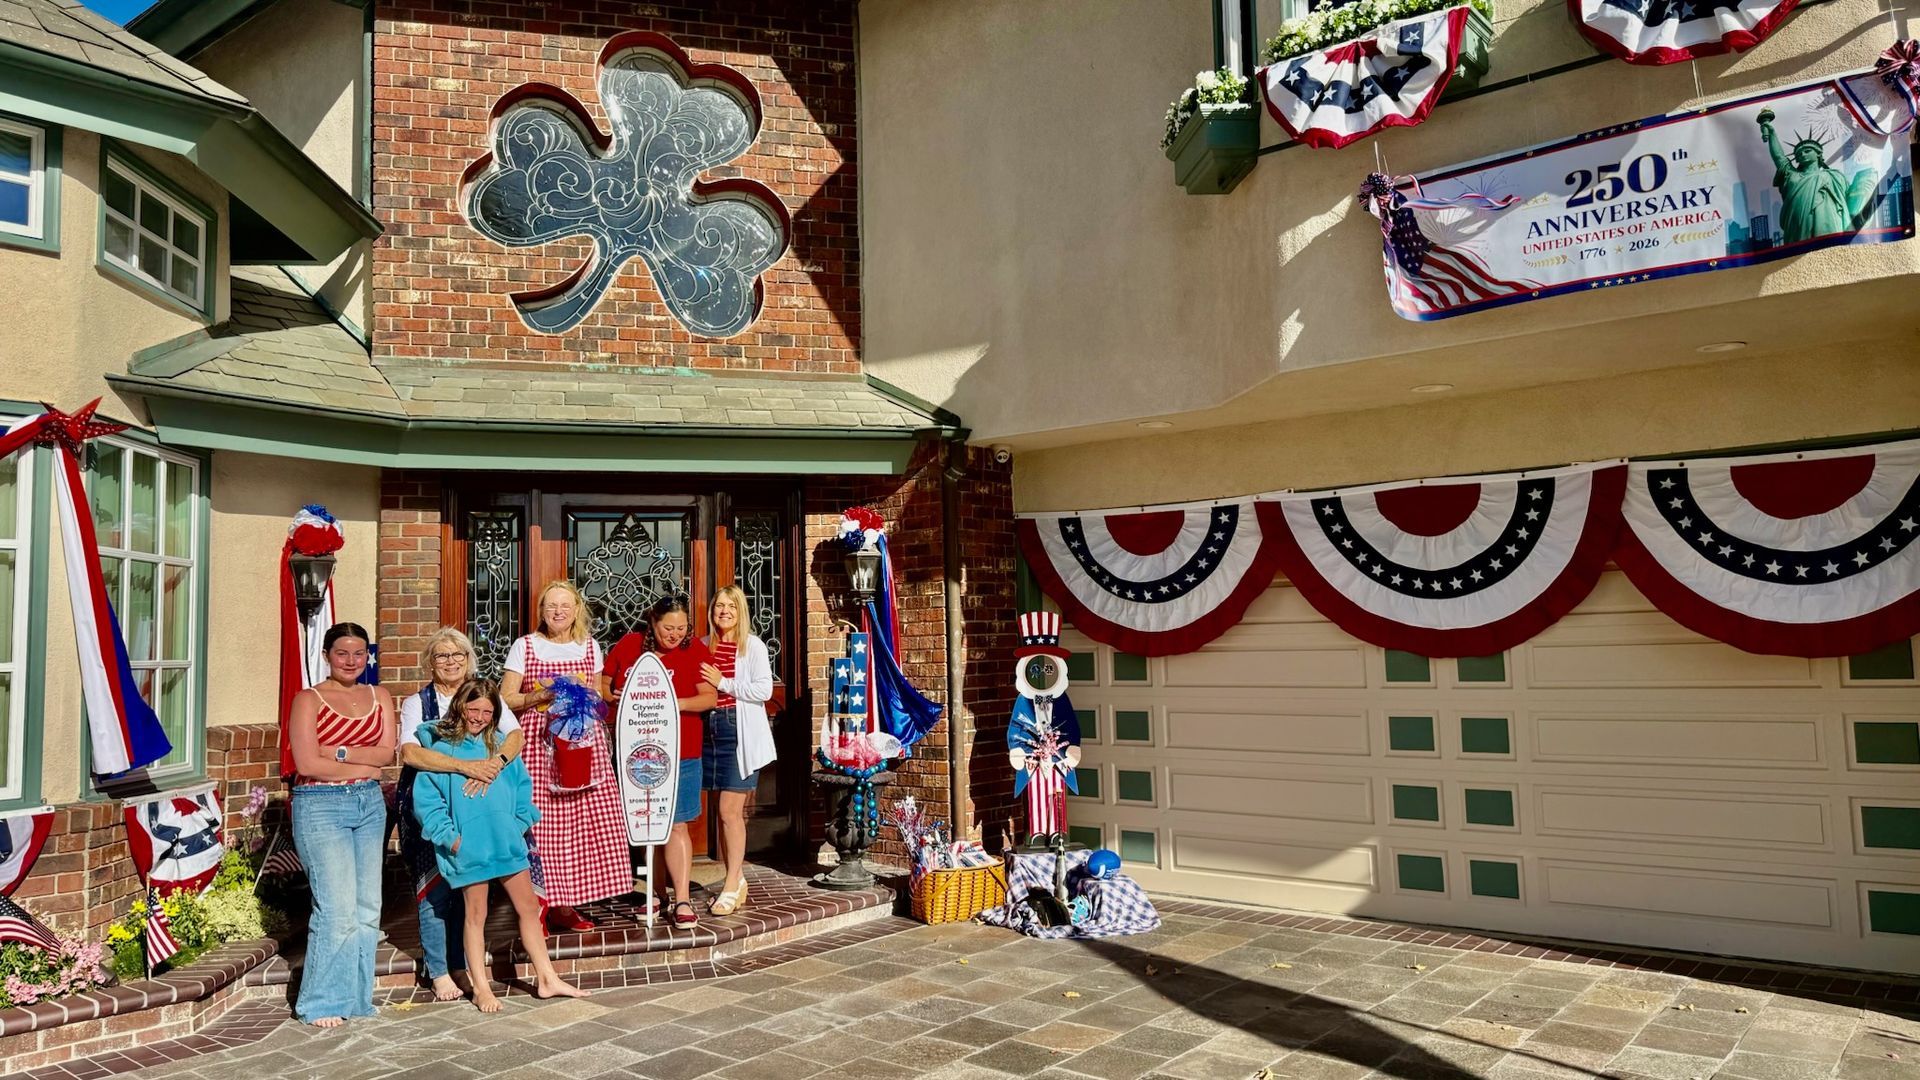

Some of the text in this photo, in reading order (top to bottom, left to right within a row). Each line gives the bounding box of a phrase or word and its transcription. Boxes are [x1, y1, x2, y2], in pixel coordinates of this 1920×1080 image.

[1527, 186, 1716, 239] ANNIVERSARY
[1523, 210, 1721, 255] UNITED STATES OF AMERICA
[1579, 238, 1659, 260] 1776 2026
[630, 691, 667, 700] WINNER
[632, 703, 664, 712] Citywide
[628, 718, 668, 726] Decorating
